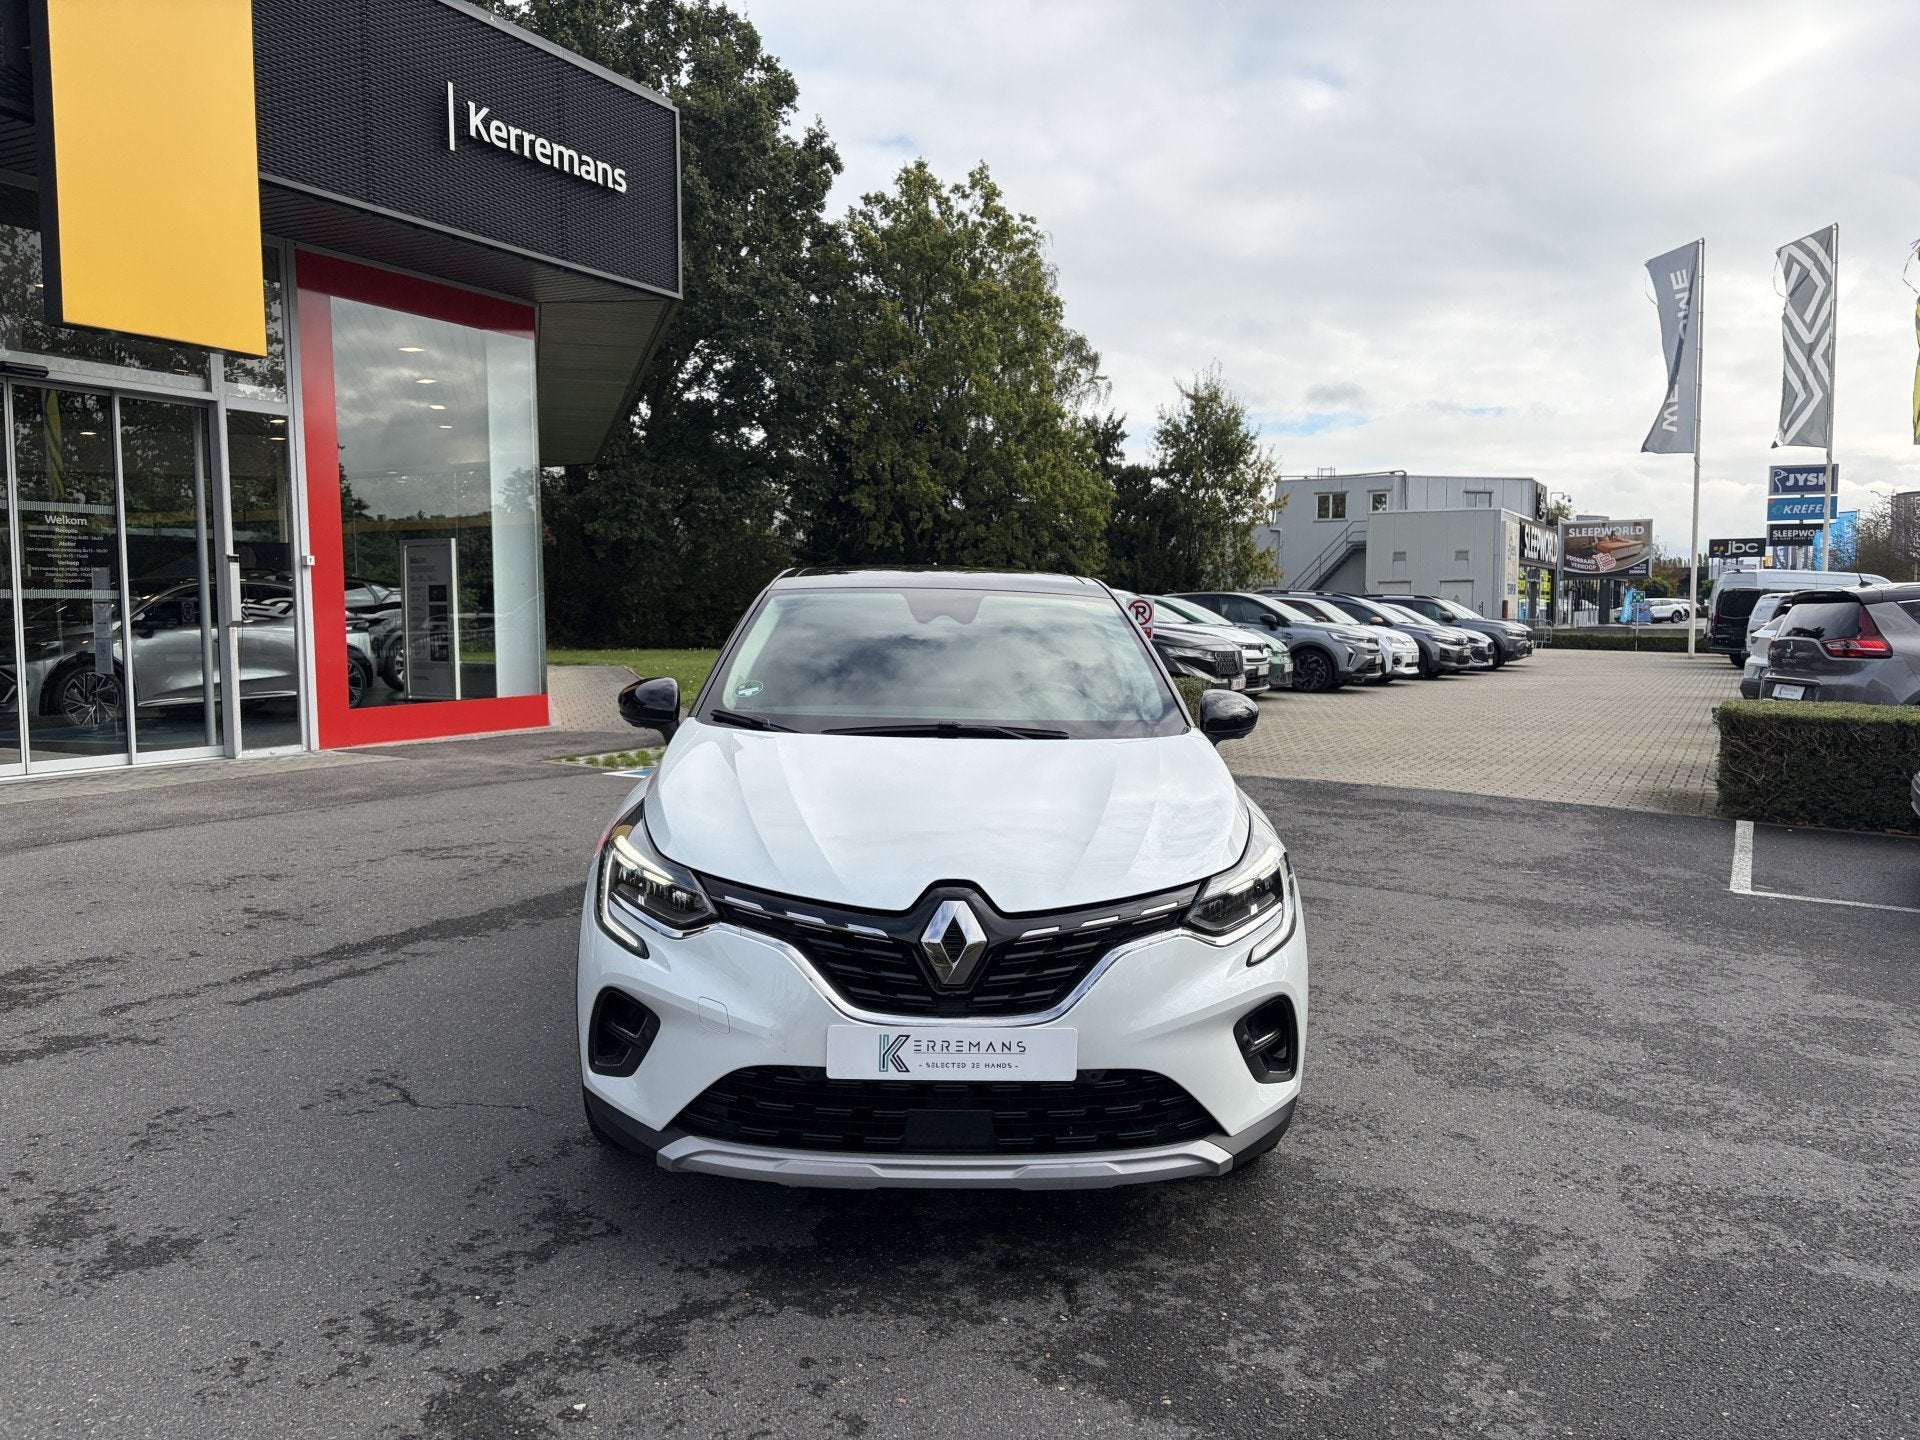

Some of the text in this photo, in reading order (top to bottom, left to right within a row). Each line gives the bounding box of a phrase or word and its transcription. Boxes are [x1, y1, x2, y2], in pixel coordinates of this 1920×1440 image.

[468, 101, 627, 193] Kerremans
[45, 515, 87, 525] Welkom
[1569, 526, 1645, 537] SLEEPWORLD
[1725, 541, 1758, 555] jbc
[1571, 562, 1597, 570] VERKOOP
[879, 1034, 1026, 1072] KERREMANS
